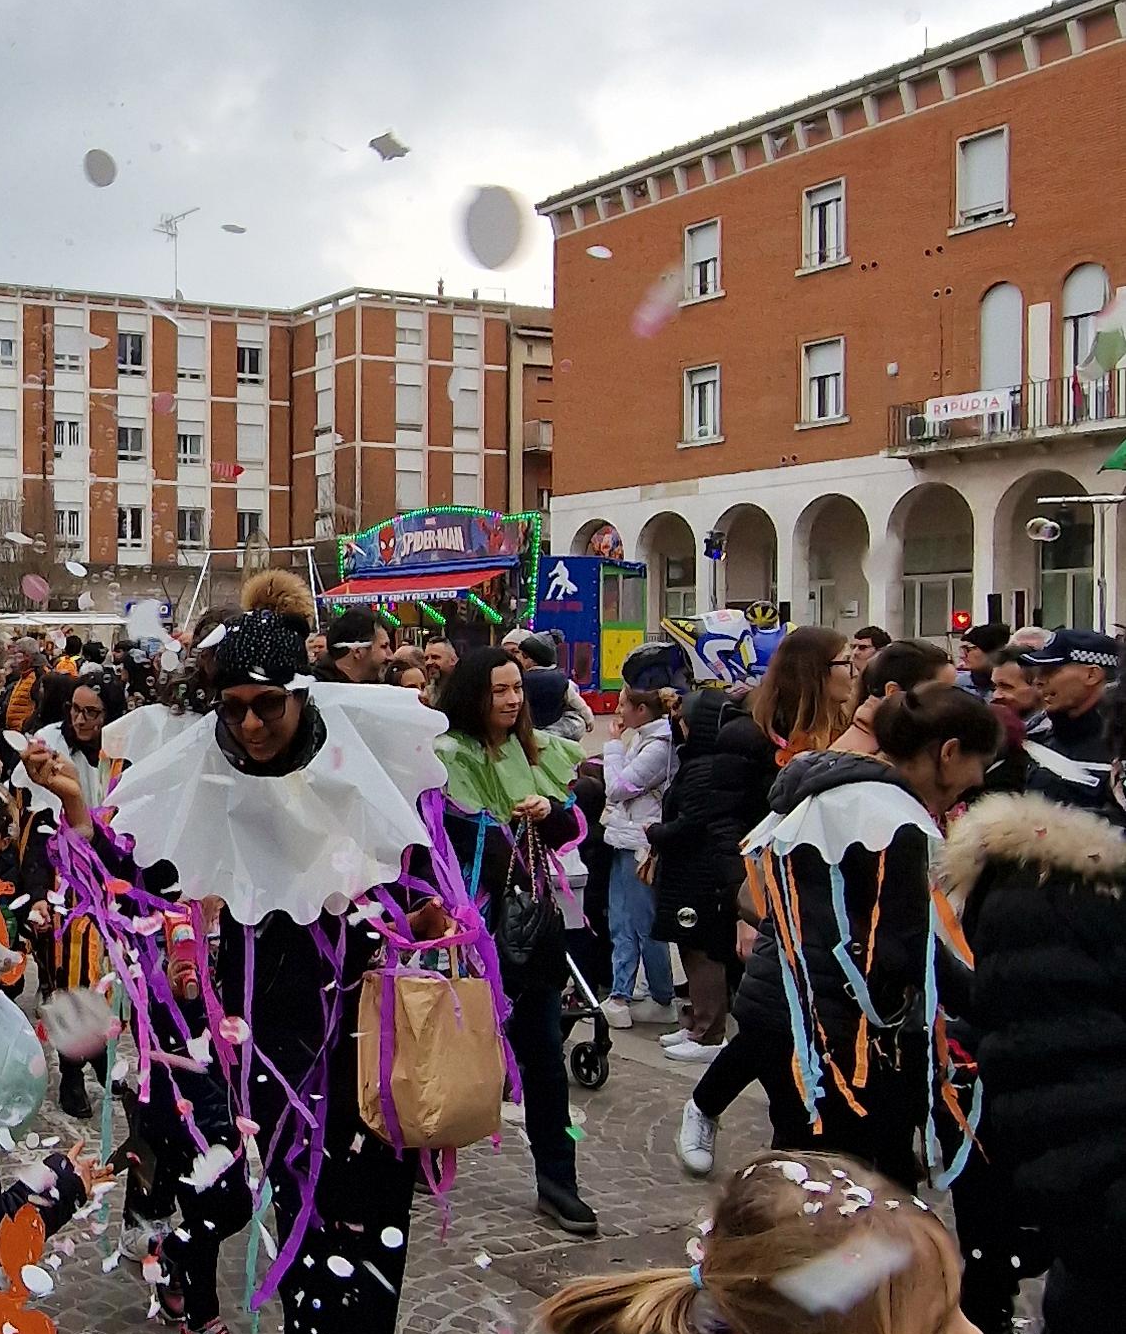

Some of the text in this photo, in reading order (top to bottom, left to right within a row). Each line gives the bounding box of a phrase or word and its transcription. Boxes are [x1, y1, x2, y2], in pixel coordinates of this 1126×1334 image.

[934, 397, 1000, 415] R1PUD1A
[401, 526, 465, 556] SPIDER-MAN
[381, 591, 457, 603] FANTASTICO
